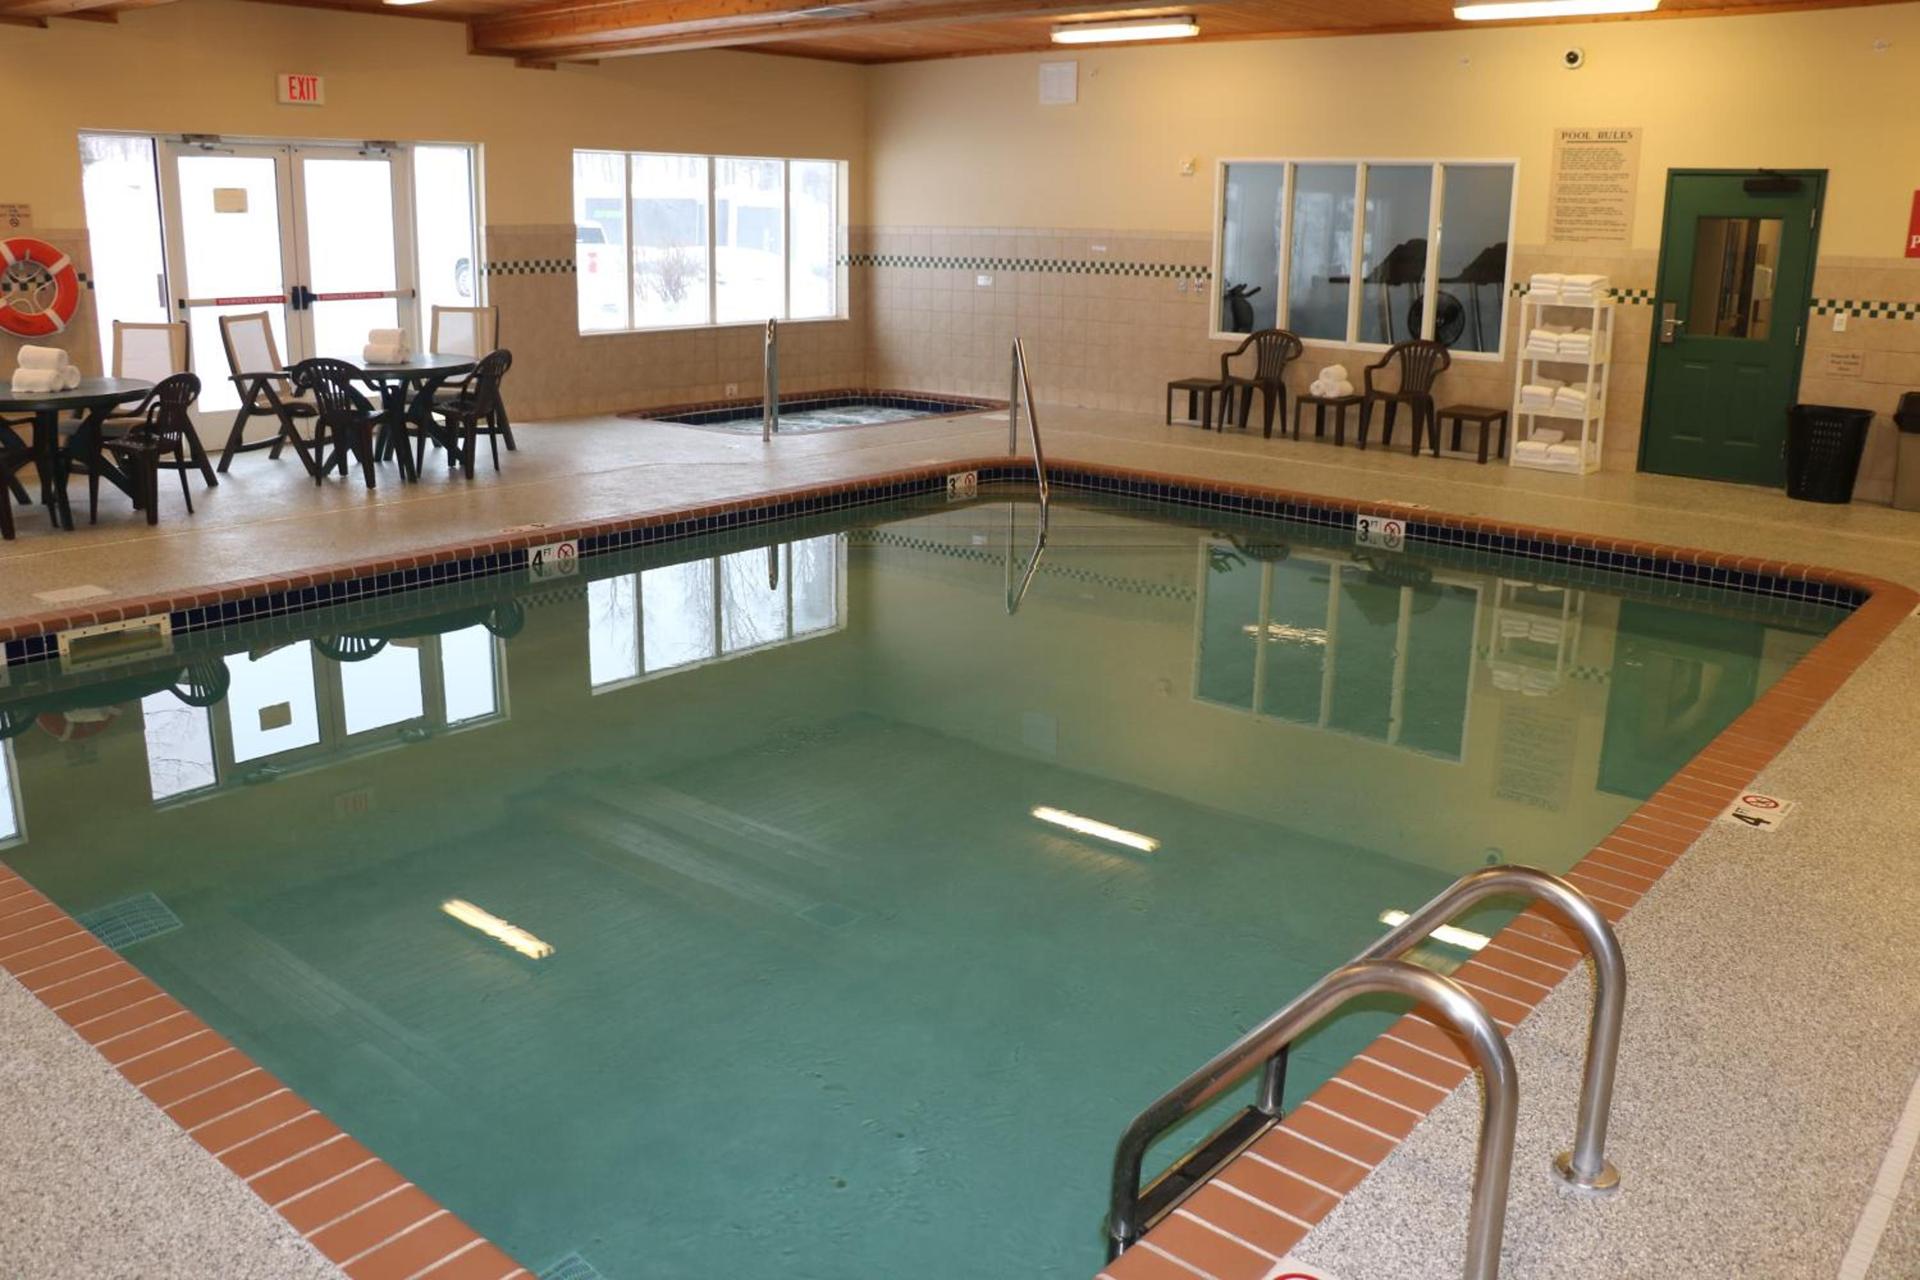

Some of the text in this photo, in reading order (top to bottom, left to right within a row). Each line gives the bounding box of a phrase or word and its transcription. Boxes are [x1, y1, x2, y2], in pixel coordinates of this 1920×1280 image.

[289, 76, 318, 101] EXIT
[1561, 131, 1633, 140] POOL RULES
[1359, 519, 1369, 533] 3
[532, 549, 544, 567] 4
[1731, 812, 1770, 827] 4
